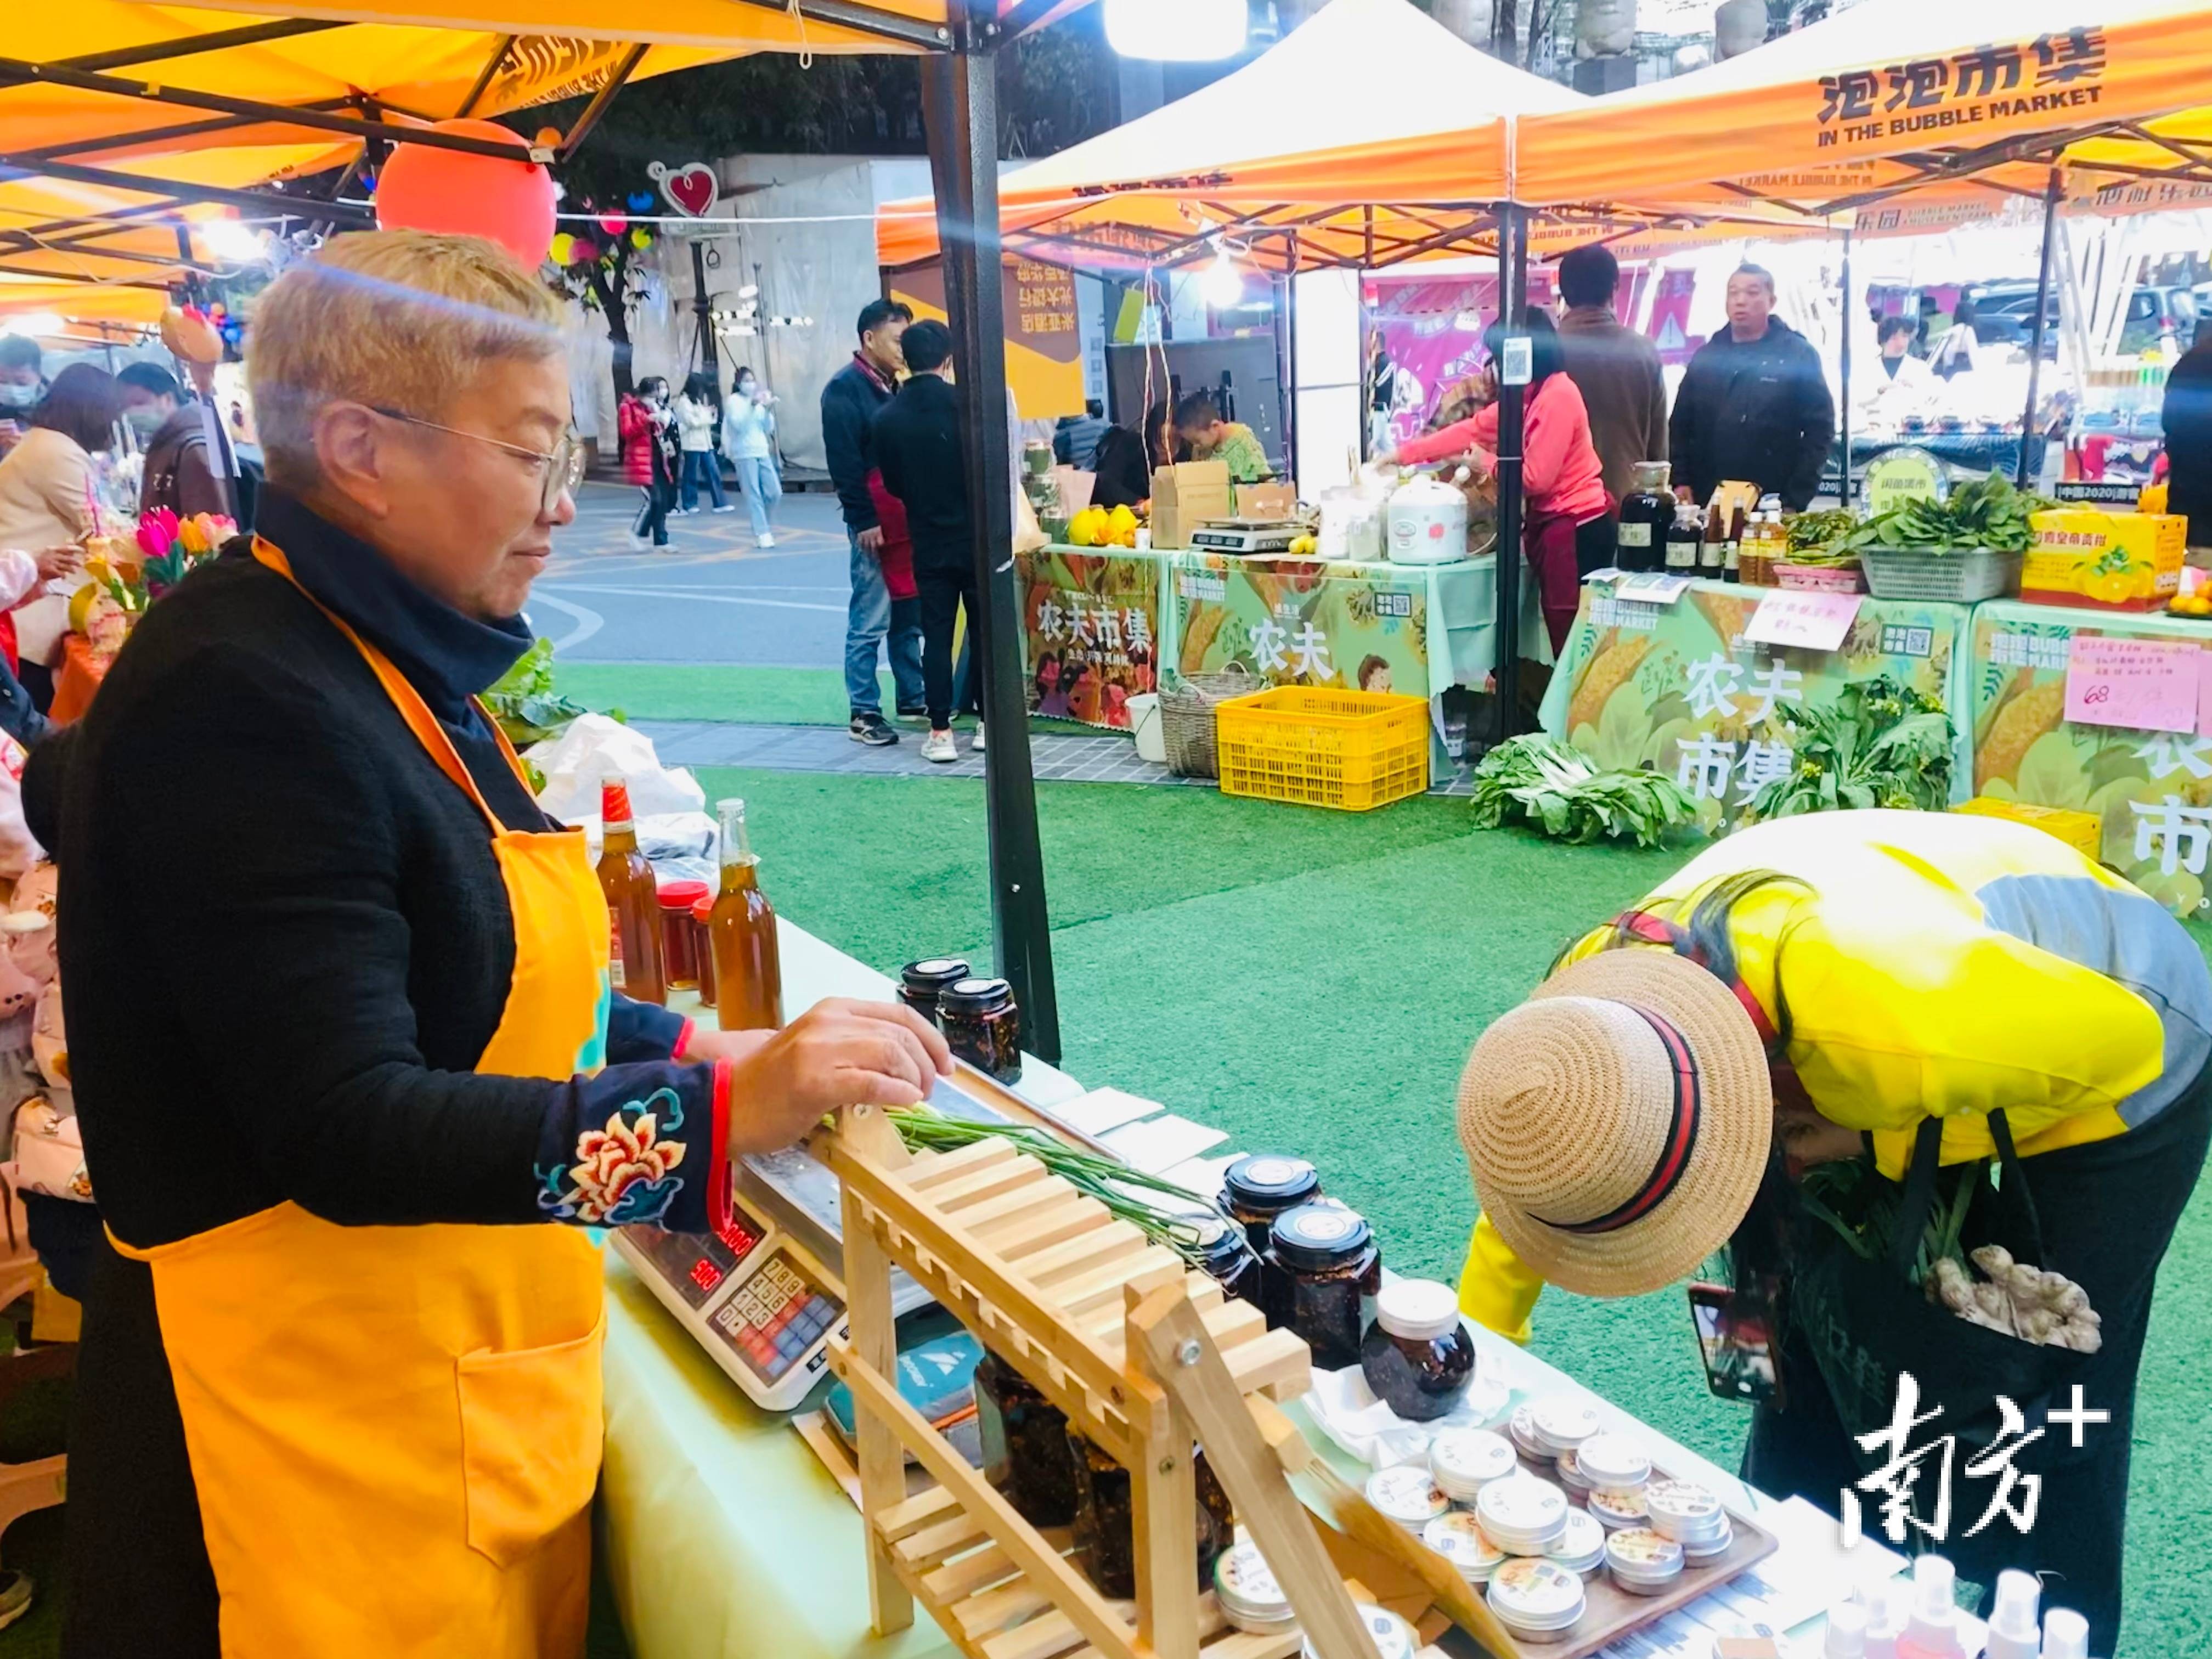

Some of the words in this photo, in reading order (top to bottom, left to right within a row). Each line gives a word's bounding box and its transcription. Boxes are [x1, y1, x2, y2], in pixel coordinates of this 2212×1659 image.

[1816, 25, 2106, 124] 泡泡市集
[1818, 129, 1837, 146] IN
[1844, 122, 1884, 142] THE
[1890, 105, 1983, 135] BUBBLE
[1990, 86, 2103, 119] MARKET
[1037, 599, 1152, 654] 农夫市集
[1249, 617, 1335, 680] 农夫
[1682, 651, 1803, 726] 农夫
[2084, 685, 2109, 704] 68
[1676, 731, 1794, 807] 市集
[2129, 795, 2212, 876] 市
